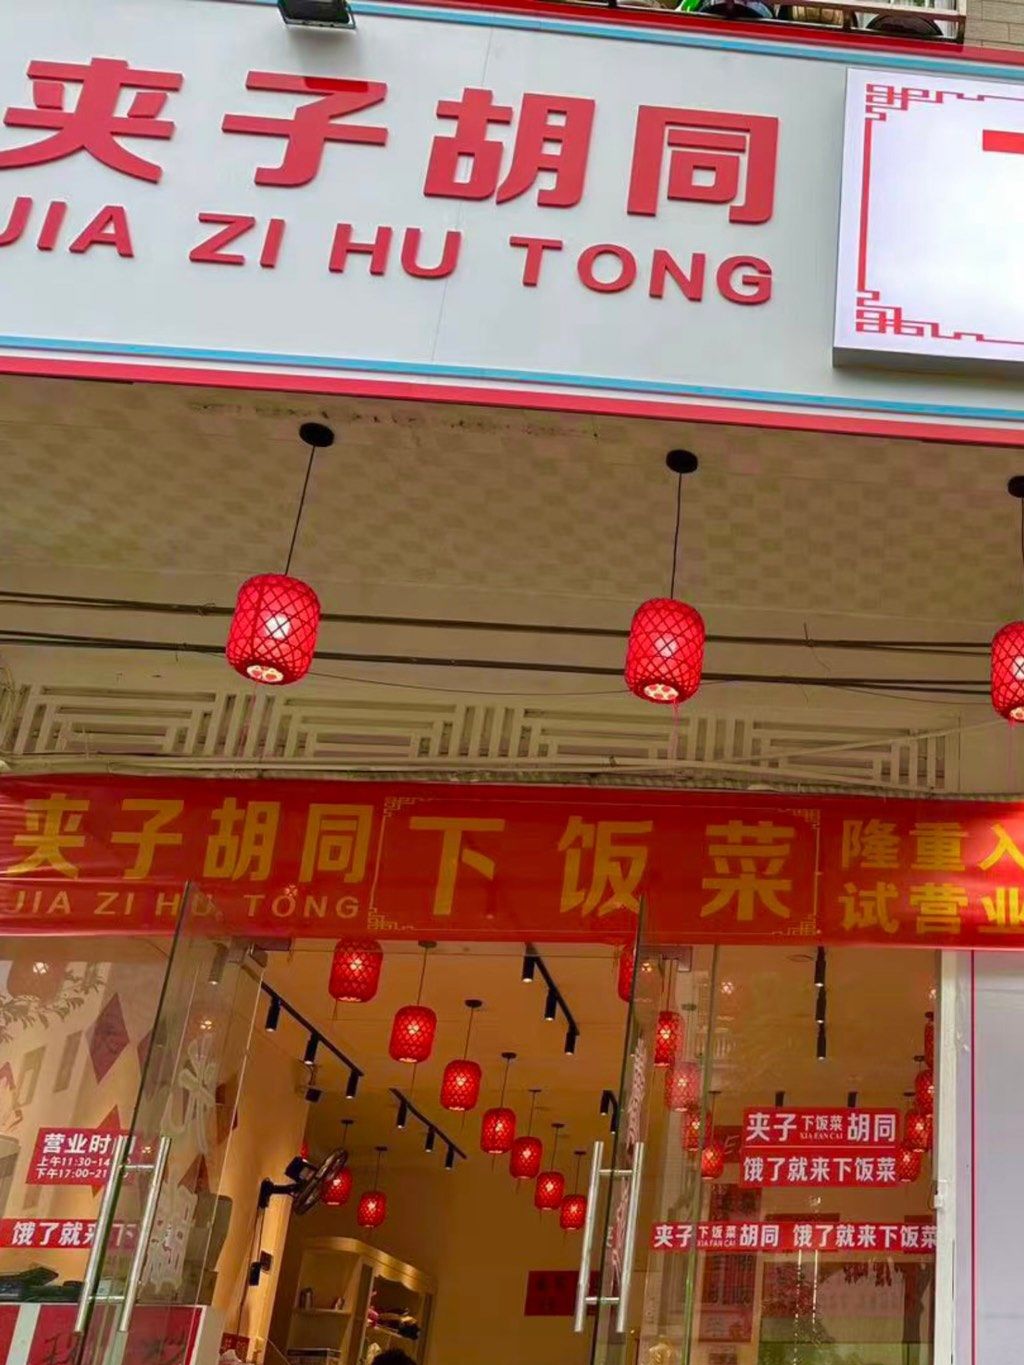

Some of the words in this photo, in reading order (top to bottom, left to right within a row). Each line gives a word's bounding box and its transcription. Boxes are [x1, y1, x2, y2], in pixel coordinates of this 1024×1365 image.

[0, 58, 780, 224] 夹子胡同
[0, 197, 134, 258] JIA
[189, 212, 285, 268] ZI
[328, 222, 463, 278] HU
[509, 235, 773, 305] TONG
[8, 793, 377, 884] 夹子胡同
[408, 815, 796, 922] 下饭菜
[5, 889, 71, 915] JIA
[94, 891, 134, 915] ZI
[243, 893, 360, 920] TONG
[745, 1112, 797, 1142] 夹子
[801, 1115, 843, 1131] 下饭菜
[847, 1112, 896, 1142] 胡同
[743, 1156, 897, 1183] 饿了就来下饭菜
[654, 1225, 693, 1248] 夹子
[739, 1224, 780, 1247] 胡同
[793, 1225, 938, 1249] 饿了就来下饭菜
